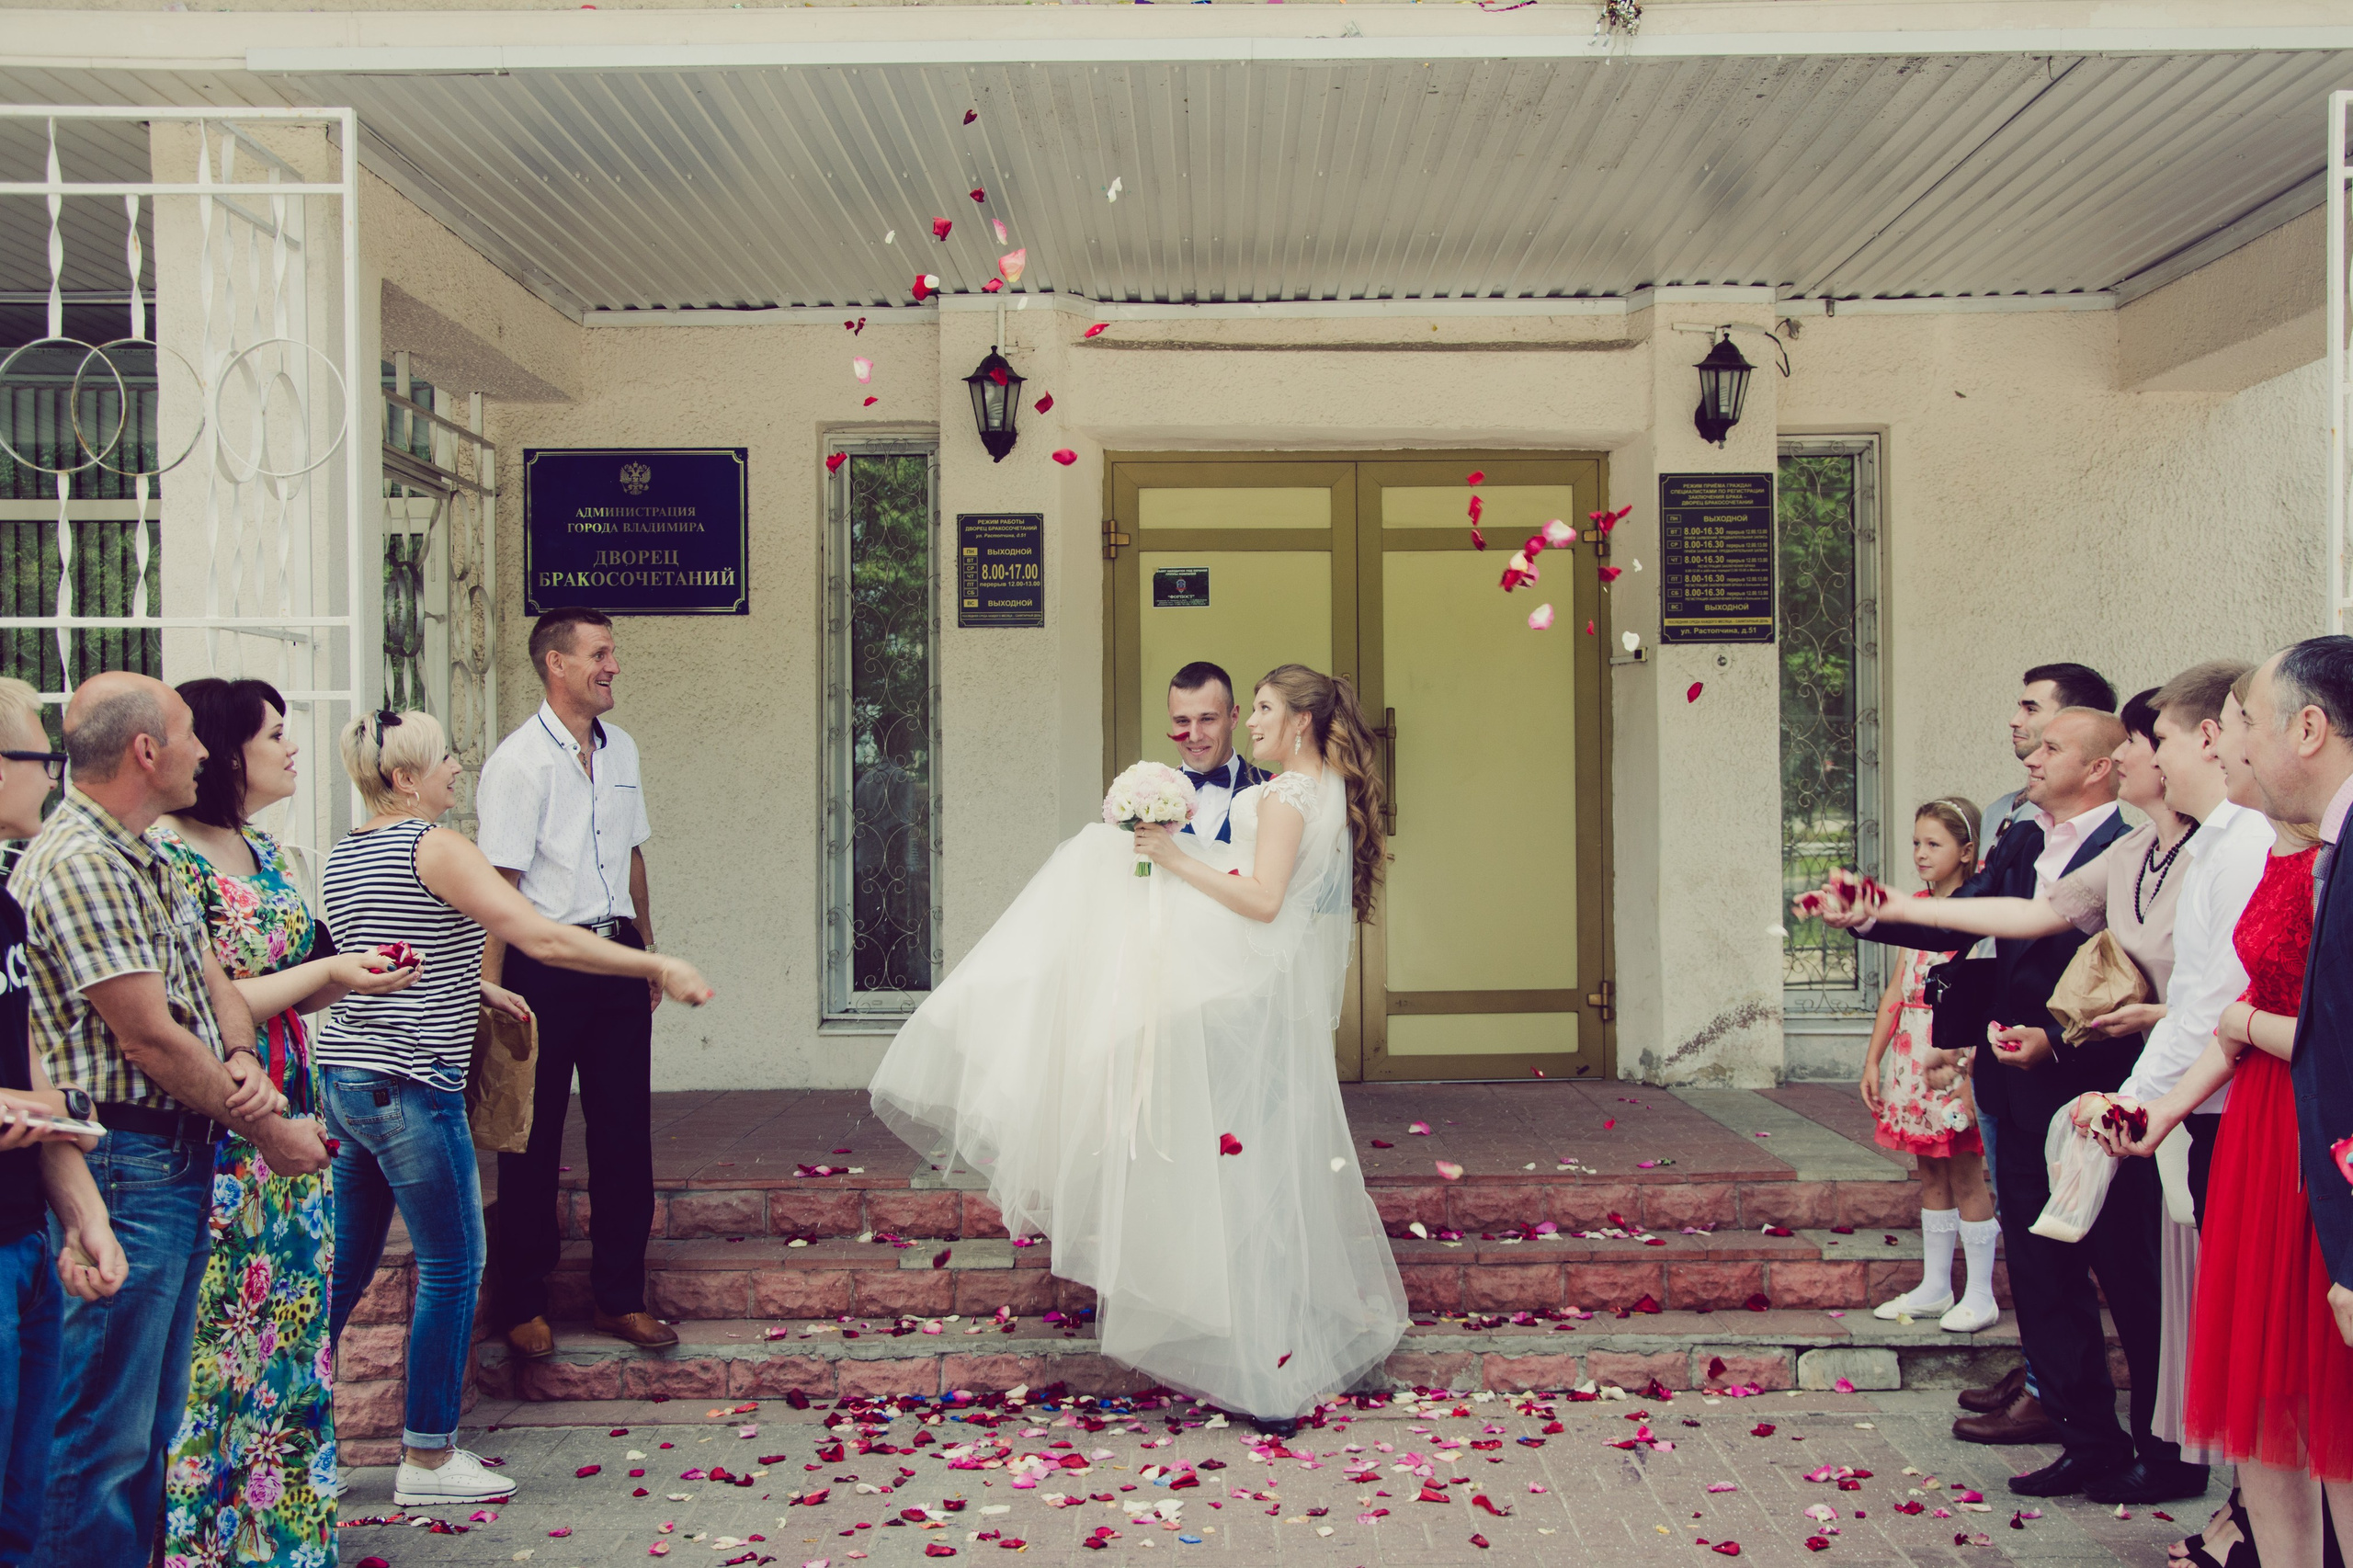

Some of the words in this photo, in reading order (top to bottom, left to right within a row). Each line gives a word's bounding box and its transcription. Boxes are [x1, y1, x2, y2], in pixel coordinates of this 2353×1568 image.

[575, 506, 697, 519] АДМИНИСТРАЦИЯ
[1703, 515, 1748, 523] ВЫХОДНОЙ
[567, 522, 619, 534] ГОРОДА
[623, 522, 705, 534] ВЛАДИМИРА
[1684, 540, 1724, 548] 8.00-16.30
[987, 547, 1032, 556] ВЫХОДНОЙ
[593, 549, 679, 568] ДВОРЕЦ
[982, 563, 1038, 580] 8.00-17.00
[538, 567, 736, 587] БРАКОСОЧЕТАНИЙ
[1685, 588, 1725, 597] 8.00-16.30
[988, 599, 1033, 607] ВЫХОДНОЙ
[1705, 603, 1749, 611] ВЫХОДНОЙ
